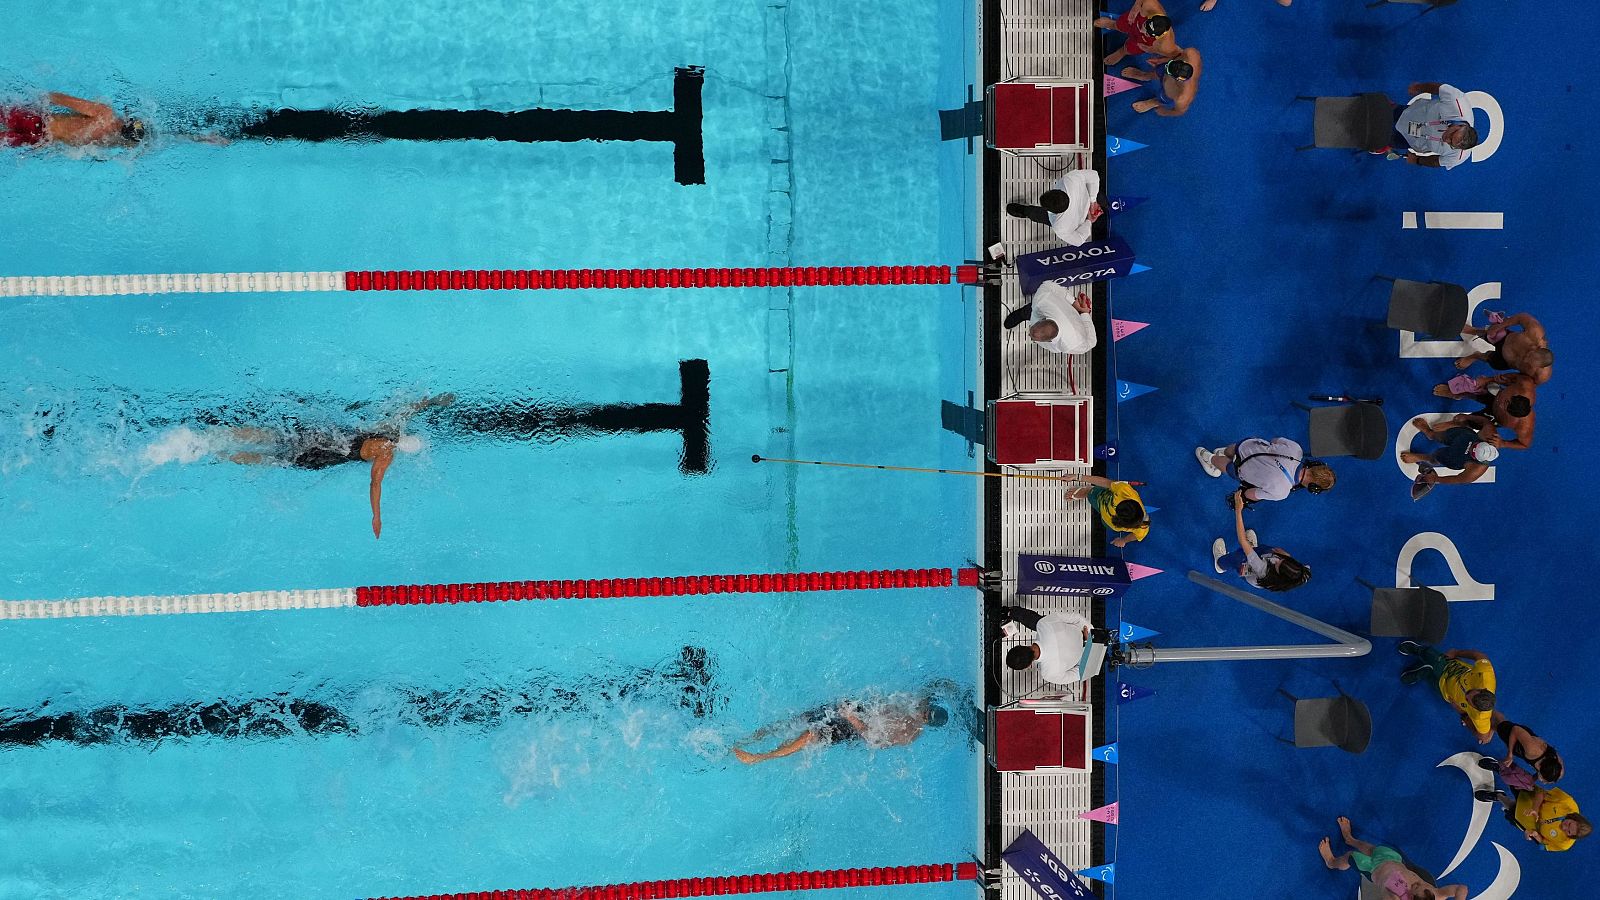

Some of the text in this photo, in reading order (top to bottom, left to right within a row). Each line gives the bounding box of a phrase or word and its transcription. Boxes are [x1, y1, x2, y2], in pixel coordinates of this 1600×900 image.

[1036, 245, 1116, 266] TOYOTA
[1053, 267, 1117, 285] OYOTA
[1058, 563, 1115, 576] Allianz
[1031, 585, 1091, 594] Allianz
